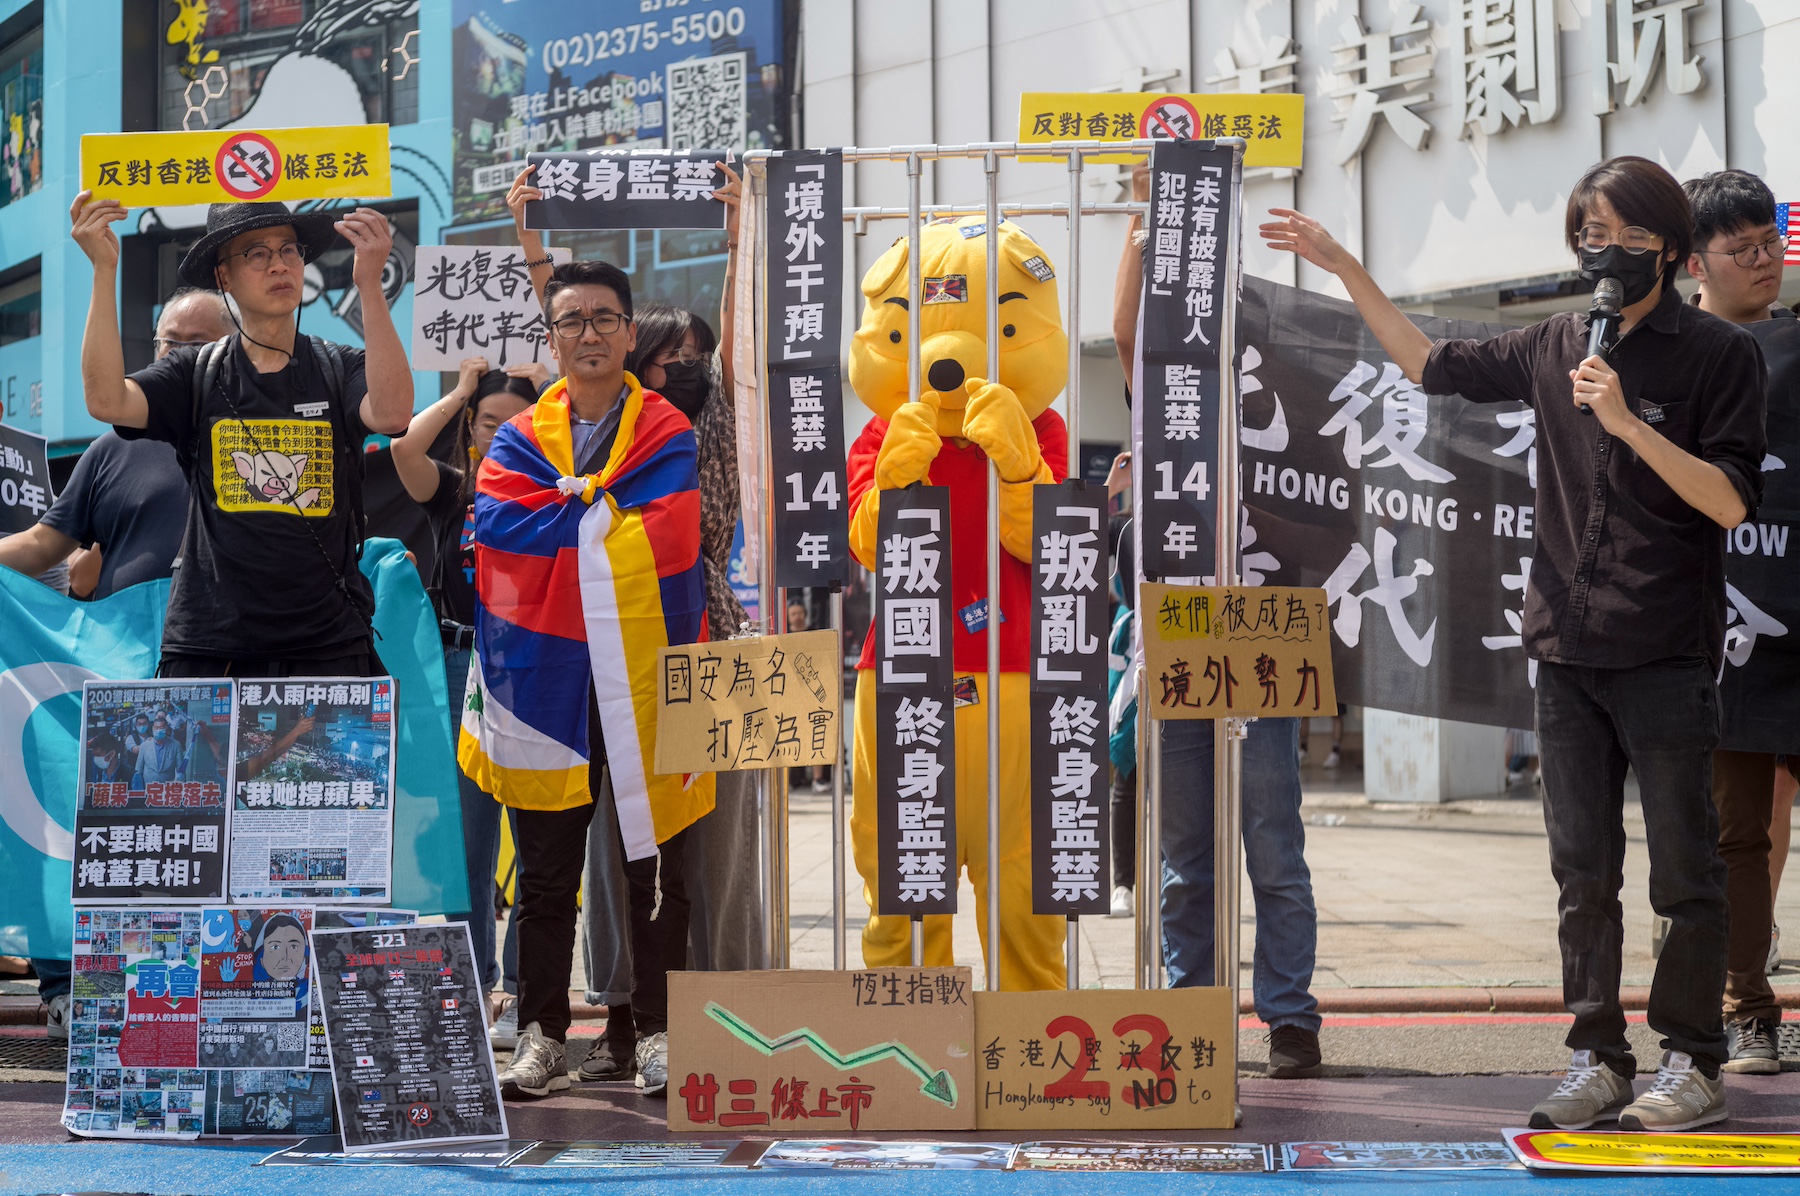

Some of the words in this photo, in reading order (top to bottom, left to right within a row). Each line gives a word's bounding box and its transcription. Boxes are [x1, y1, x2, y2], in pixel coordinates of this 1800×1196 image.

[542, 7, 746, 74] (02)2375-5500
[510, 71, 664, 120] 現在上Facebook
[1031, 111, 1136, 139] 反對香港
[1203, 112, 1283, 140] 條惡法
[98, 157, 212, 187] 反對香港
[284, 151, 369, 180] 條惡法
[536, 158, 715, 201] 終身監禁
[784, 164, 826, 361] 「境外干預」
[1151, 171, 1187, 296] 犯叛國罪」
[1183, 165, 1222, 346] 「未有披露他人
[1253, 462, 1350, 510] HONG
[1364, 484, 1458, 532] KONG
[882, 508, 942, 684] 「叛國」
[1037, 506, 1099, 683] 「叛亂」
[240, 684, 371, 706] 港人雨中痛別
[665, 646, 786, 706] 國安為名
[1159, 652, 1321, 711] 境外勢力
[706, 706, 834, 770] 打壓為實
[895, 696, 946, 903] 終身監禁
[1049, 695, 1100, 903] 終身監禁
[81, 824, 219, 854] 不要讓中國
[234, 960, 254, 968] CHINA
[345, 949, 443, 967] 全球反廿三集會
[371, 933, 406, 948] 323
[135, 963, 199, 998] 再會
[982, 1036, 1217, 1072] 香港人堅決反對
[1043, 1013, 1176, 1108] 23
[679, 1072, 876, 1131] 廿三條上市
[985, 1081, 1075, 1112] Hongkongers
[1088, 1094, 1111, 1115] say
[1132, 1078, 1177, 1109] NO
[1187, 1078, 1212, 1104] to
[1328, 1147, 1510, 1161] 不要23條
